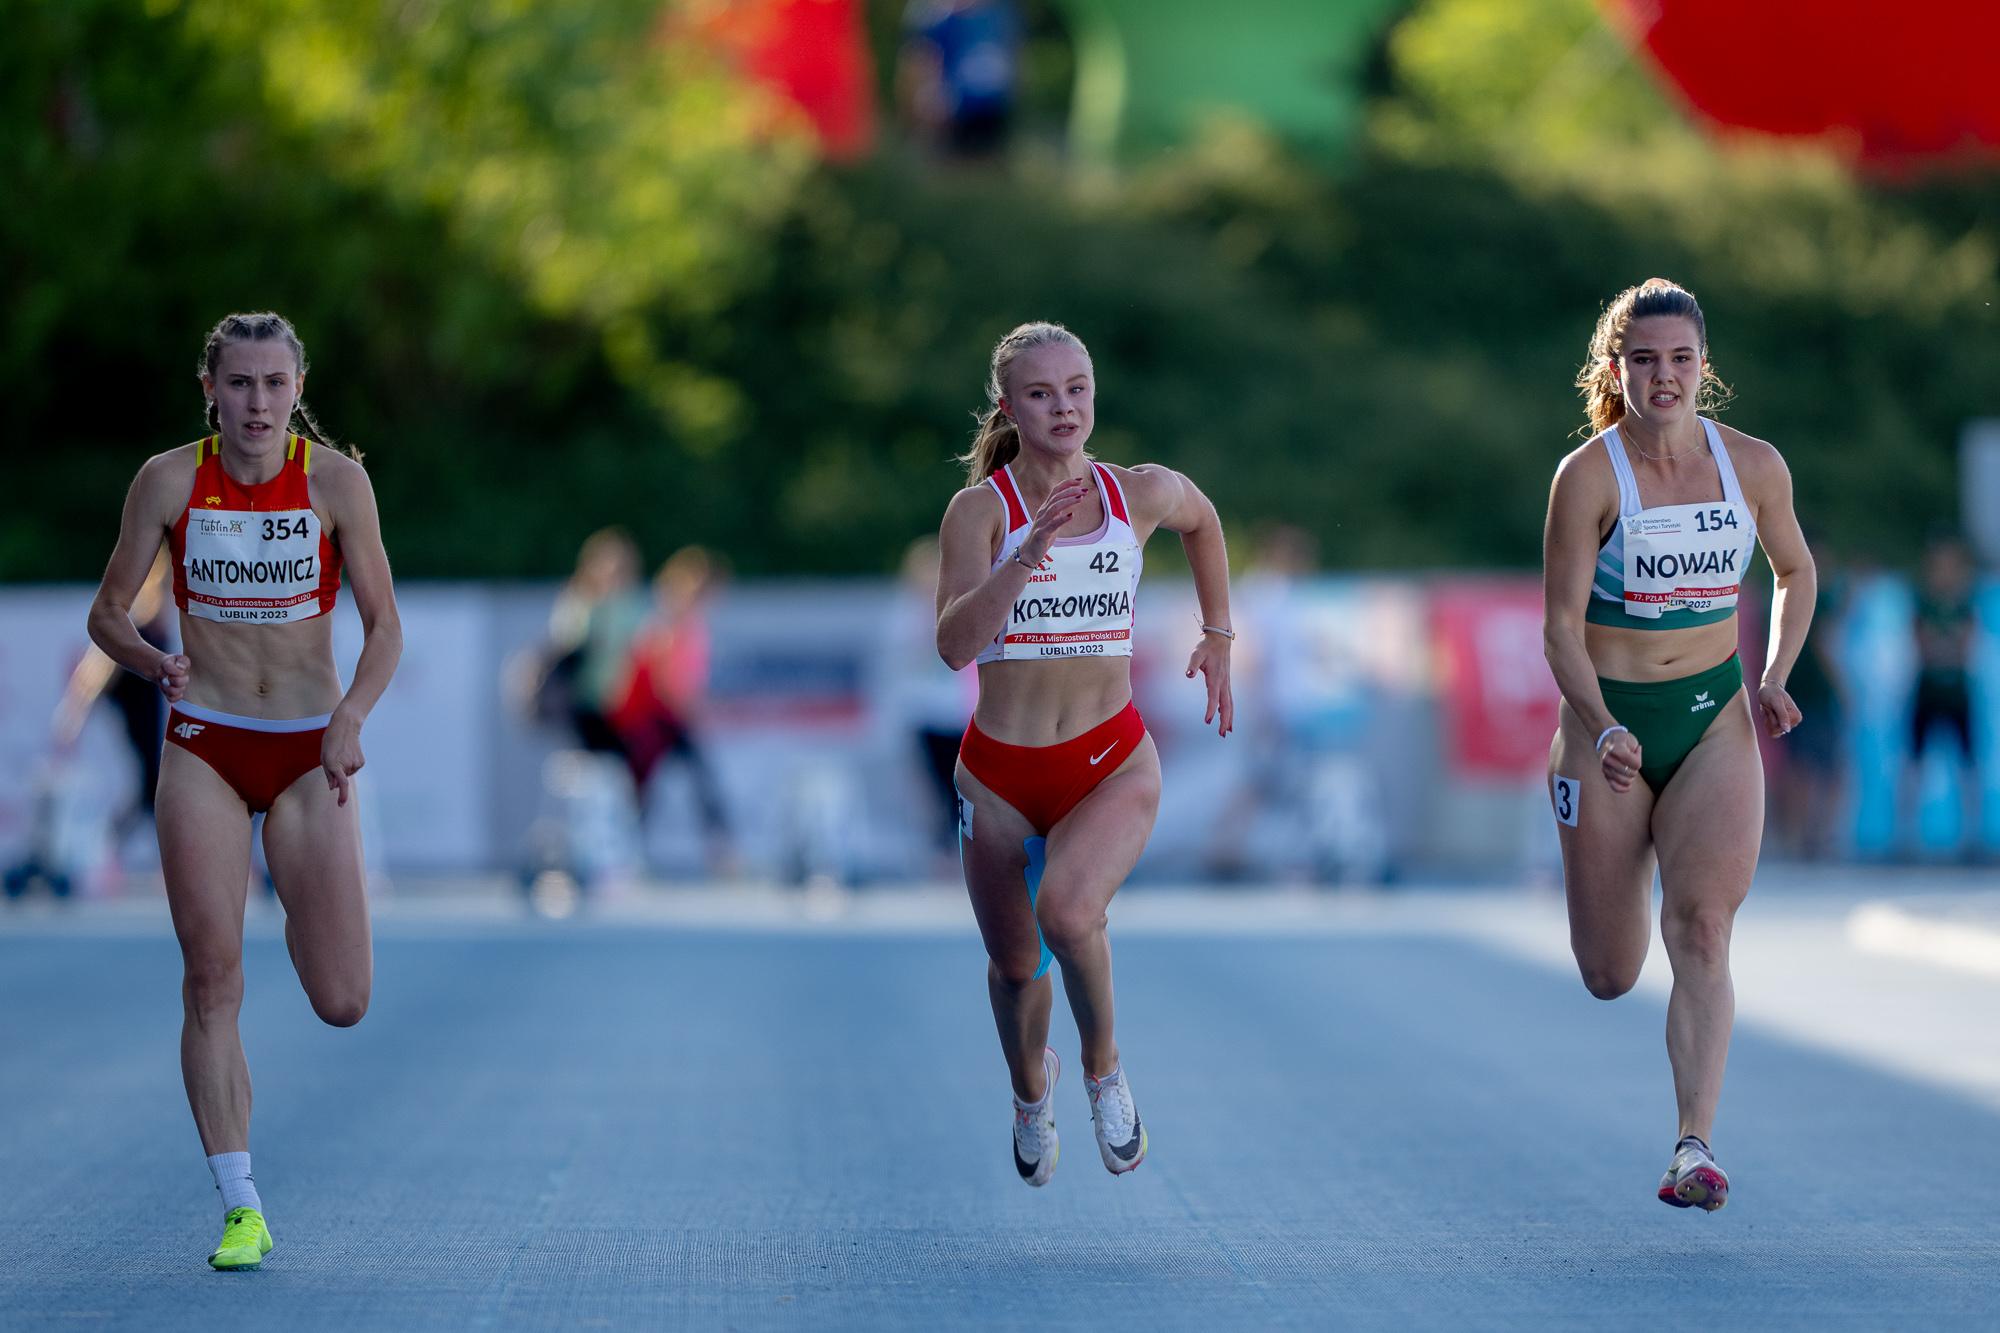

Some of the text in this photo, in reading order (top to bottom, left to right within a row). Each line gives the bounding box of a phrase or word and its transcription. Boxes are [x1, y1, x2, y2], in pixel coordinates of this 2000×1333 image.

[261, 517, 309, 541] 354
[1694, 509, 1738, 532] 154
[191, 556, 315, 584] ANTONOWICZ
[1089, 551, 1119, 573] 42
[1636, 548, 1738, 579] NOWAK
[195, 593, 311, 608] 77. PZLA Mistrzostwa Polski U20
[1633, 593, 1644, 601] 77.
[1702, 588, 1721, 597] Polski
[1721, 587, 1734, 595] U20
[1013, 591, 1130, 624] KOZŁOWSKA
[1688, 600, 1712, 609] 2023
[219, 610, 288, 620] LUBLIN 2023
[1014, 635, 1025, 643] 77.
[1046, 633, 1090, 643] Mistrzostwa
[1090, 632, 1112, 641] Polski
[1113, 631, 1126, 639] U20
[1040, 644, 1104, 656] LUBLIN 2023
[1691, 699, 1716, 712] erima
[174, 722, 205, 739] 4F
[1558, 780, 1572, 821] 3
